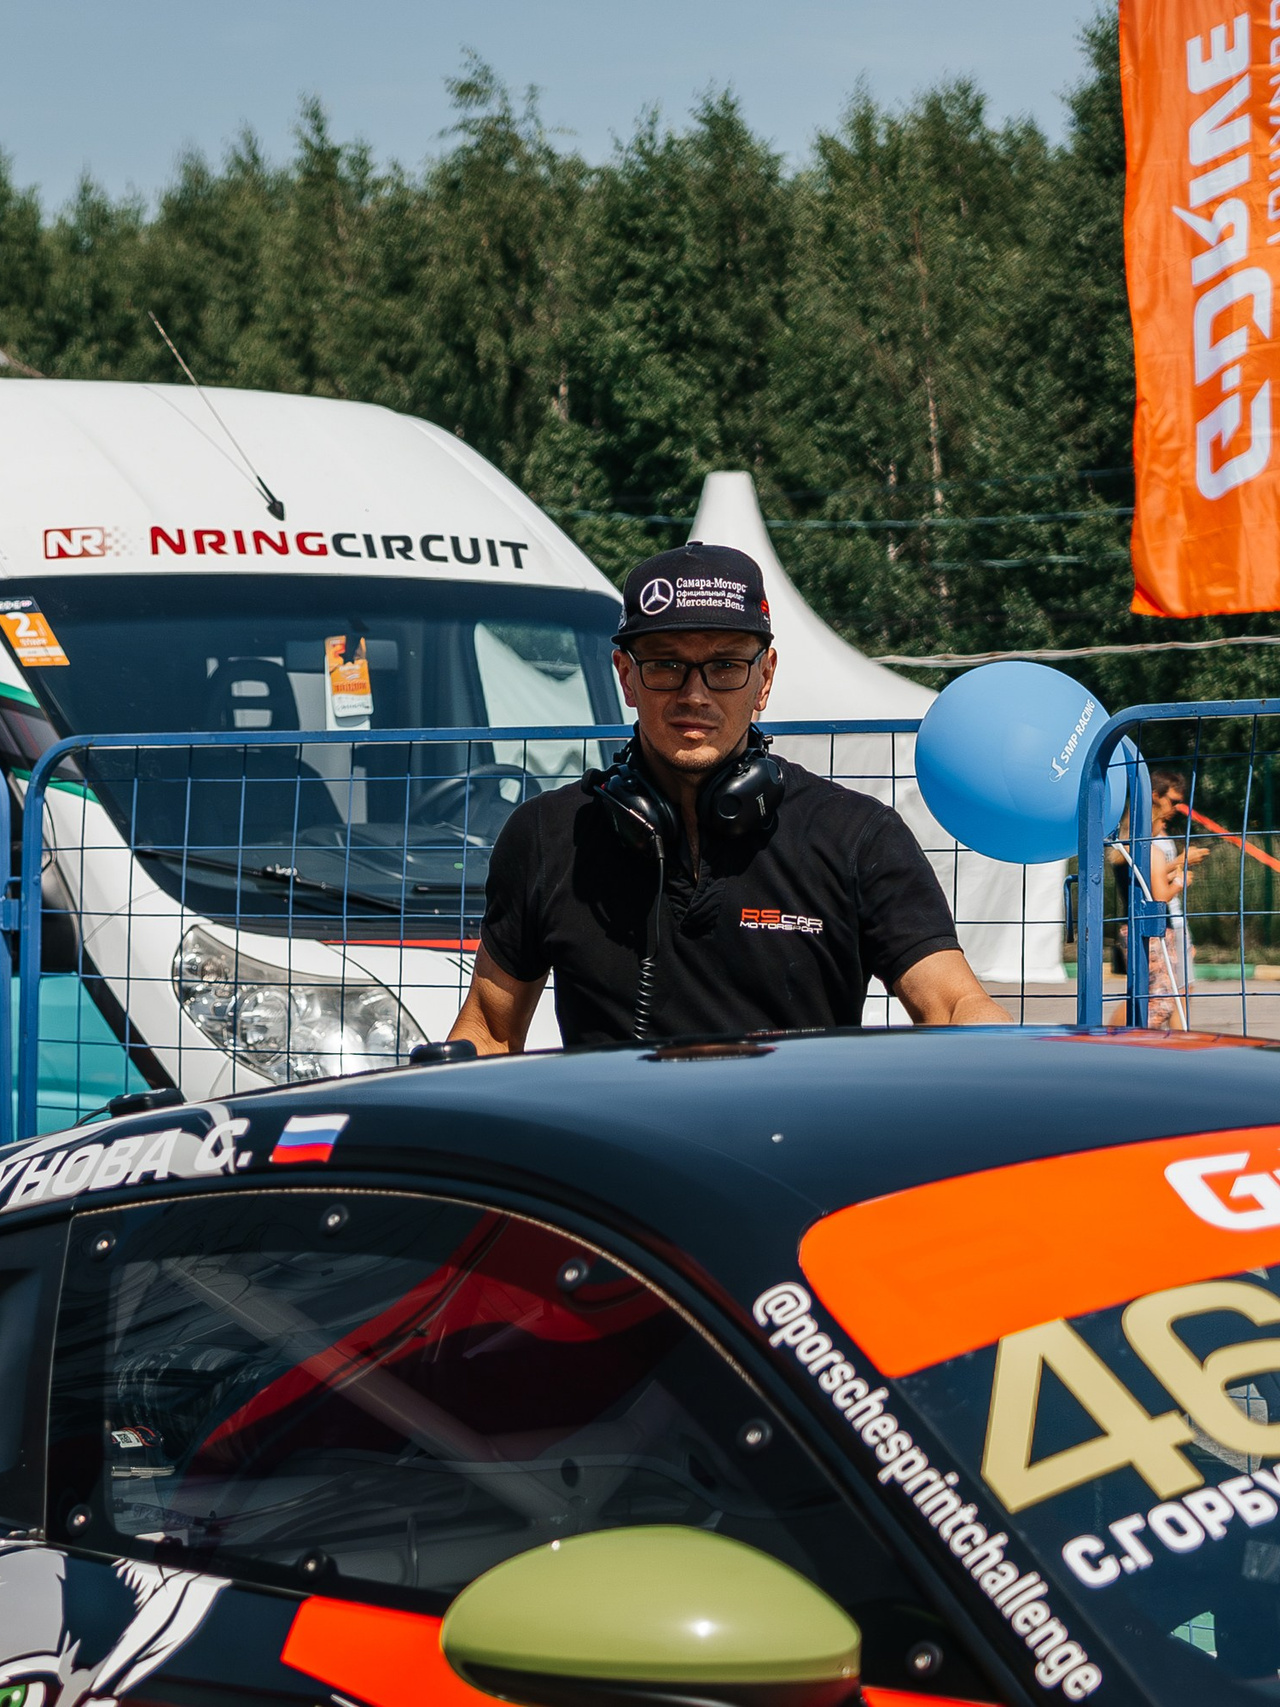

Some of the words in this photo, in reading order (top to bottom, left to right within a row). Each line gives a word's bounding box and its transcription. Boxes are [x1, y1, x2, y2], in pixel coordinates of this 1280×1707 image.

[149, 525, 529, 570] NRINGCIRCUIT
[676, 577, 748, 593] Самара-Моторс
[676, 597, 746, 612] Mercedes-Benz
[5, 611, 39, 638] 2
[1060, 733, 1079, 764] SMP
[1074, 698, 1096, 737] RACING
[739, 920, 823, 935] MOTORSPORT
[740, 907, 824, 928] RSCAR
[980, 1278, 1280, 1515] 46
[752, 1281, 1103, 1702] @porschesprintchallenge
